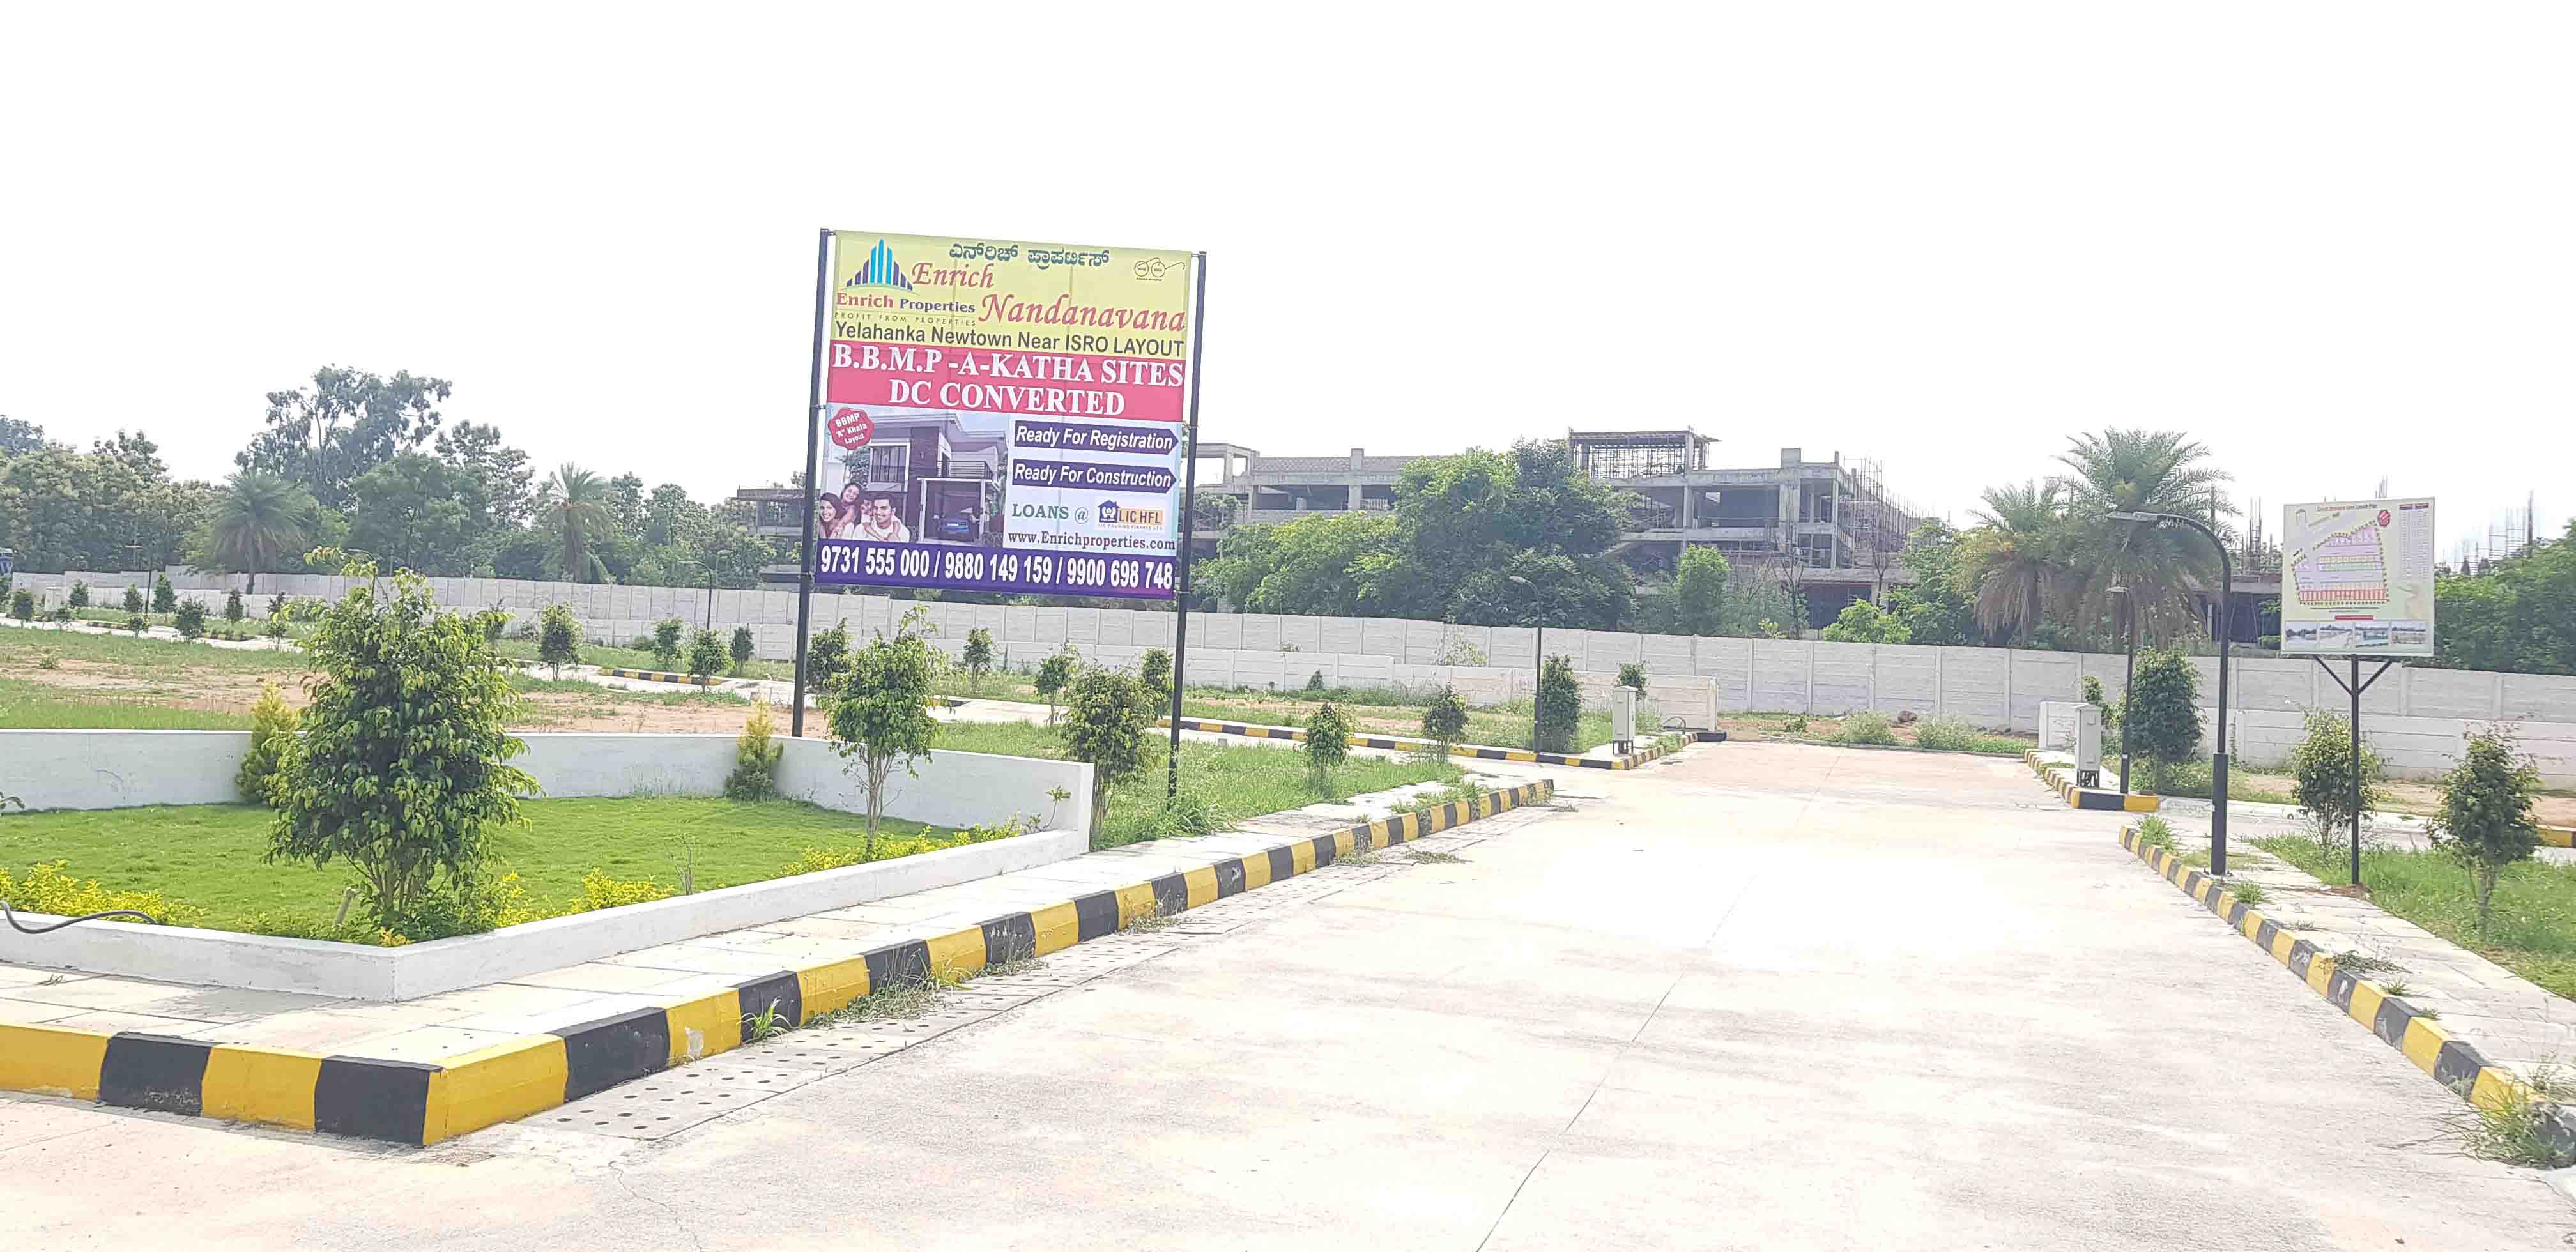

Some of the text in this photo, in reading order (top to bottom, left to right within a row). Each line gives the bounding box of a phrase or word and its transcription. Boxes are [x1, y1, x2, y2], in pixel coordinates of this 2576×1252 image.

[912, 262, 995, 288] Enrich
[836, 292, 976, 313] Enrich Properties
[978, 293, 1186, 332] Nandanavana
[834, 312, 871, 320] PROFIT
[914, 316, 976, 326] PROPERTIES
[836, 321, 1184, 357] Yelahanka Newtown Near ISRO LAYOUT
[832, 343, 942, 373] B.B.M.P
[1101, 359, 1183, 387] SITES
[888, 379, 1125, 416] DC CONVERTED
[835, 413, 860, 427] BBMP
[844, 433, 864, 445] Layout
[1016, 425, 1173, 450] Ready For Registration
[1014, 463, 1172, 487] Ready For Construction
[1011, 503, 1089, 524] LOANS @
[1119, 510, 1161, 524] LIC HFL
[1008, 531, 1176, 551] www.Enrichproperties.com
[820, 546, 1173, 590] 9731 555 000 / 9880 149 159 / 9900 698 748
